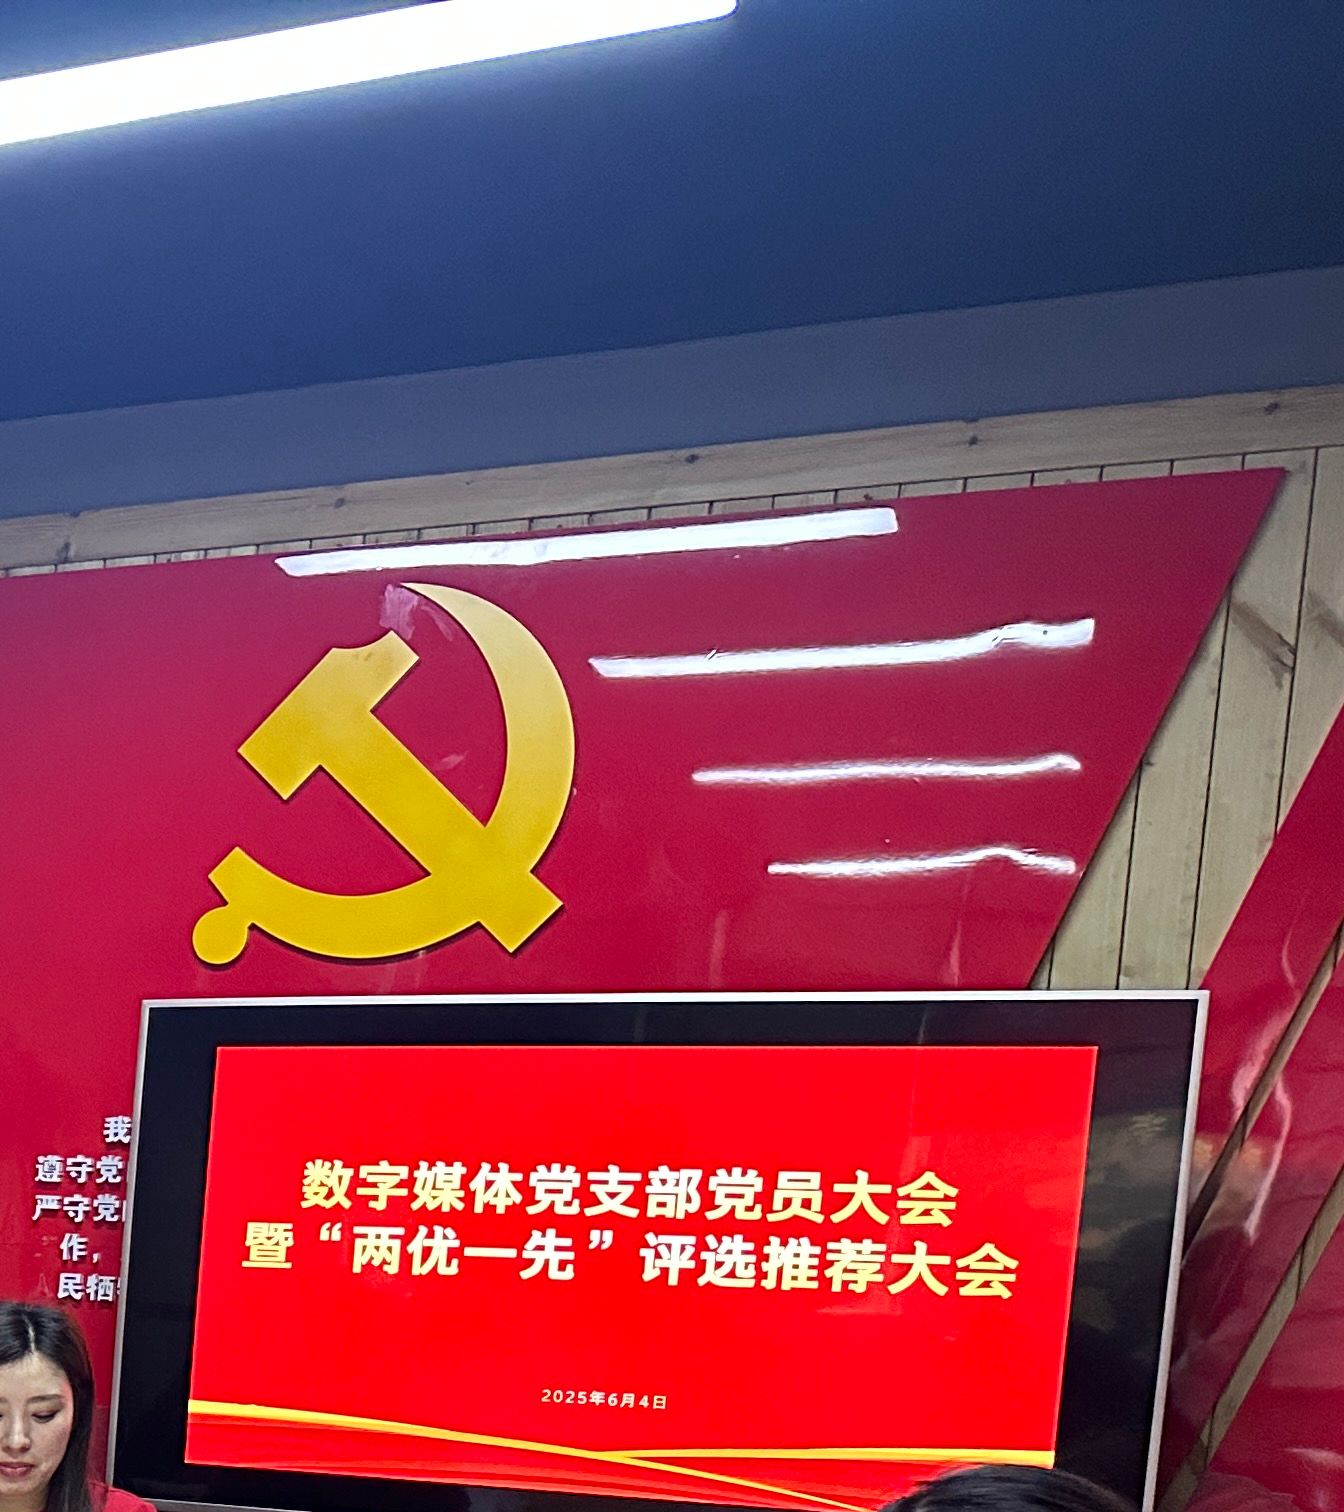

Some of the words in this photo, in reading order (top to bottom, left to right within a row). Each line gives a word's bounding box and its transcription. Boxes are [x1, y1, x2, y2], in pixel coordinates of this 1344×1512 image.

[103, 1115, 132, 1143] 我
[35, 1155, 129, 1183] 遵守党
[300, 1158, 959, 1228] 数字媒体党支部党员大会
[32, 1194, 126, 1222] 严守党
[241, 1220, 1020, 1300] 暨“两优一先”评选推荐大会
[57, 1272, 120, 1301] 民牺
[541, 1389, 667, 1410] 2025年6月4日
